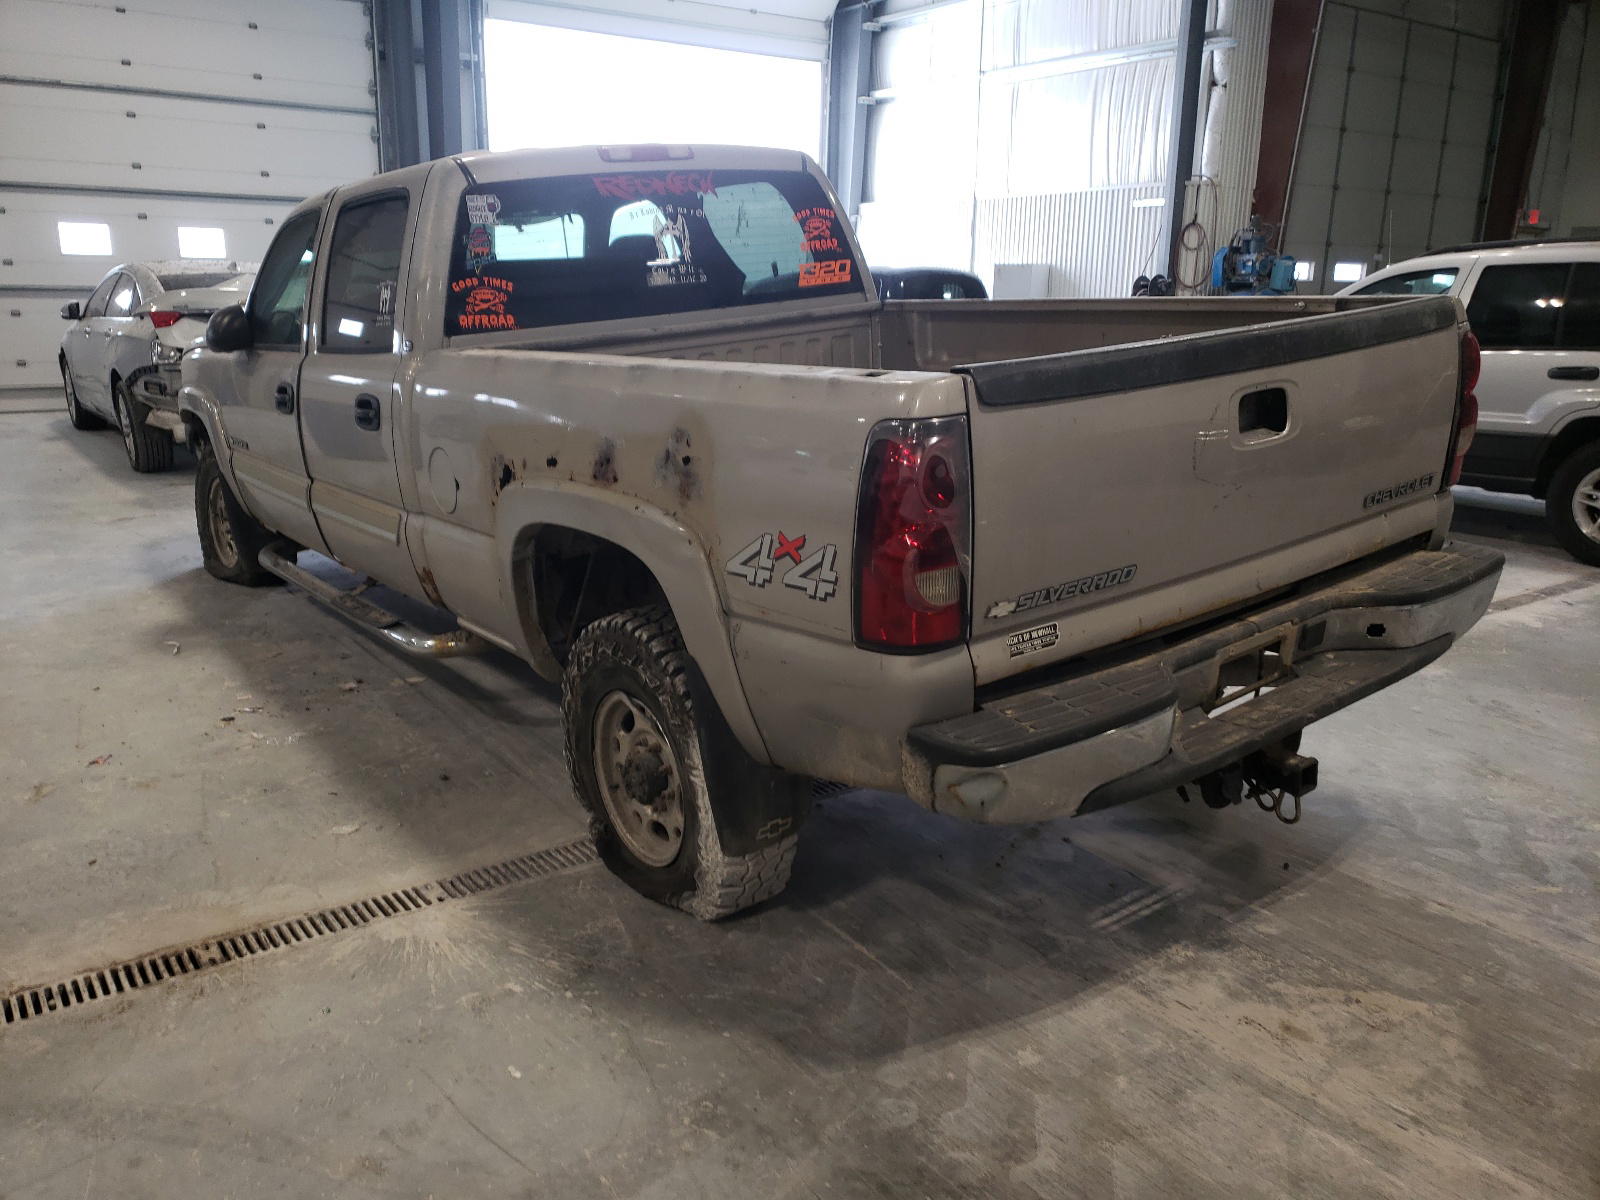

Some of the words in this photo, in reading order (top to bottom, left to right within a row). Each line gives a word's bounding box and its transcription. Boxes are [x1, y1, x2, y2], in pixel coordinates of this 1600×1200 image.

[451, 277, 479, 293] GOOD
[482, 276, 514, 294] TIMES
[458, 314, 516, 329] OFFROAD
[1363, 472, 1434, 508] CHEVROLET
[1015, 564, 1138, 612] SILVERADO
